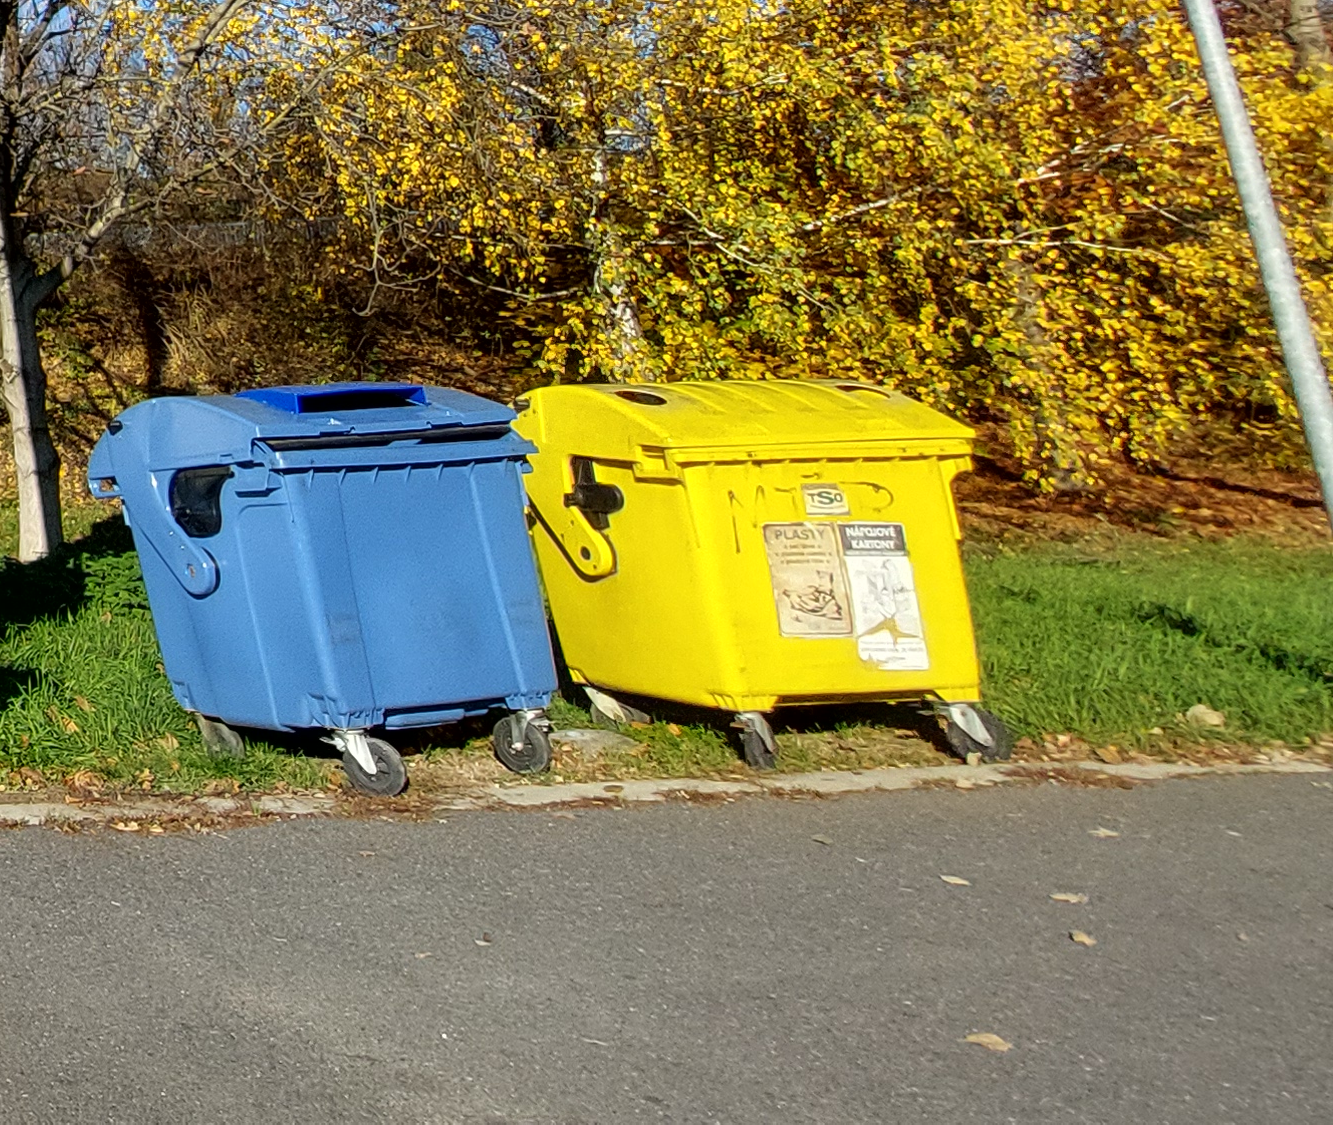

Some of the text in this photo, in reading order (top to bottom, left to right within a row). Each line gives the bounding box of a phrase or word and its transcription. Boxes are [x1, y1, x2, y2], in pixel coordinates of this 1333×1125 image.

[807, 490, 844, 506] TSO
[774, 528, 825, 541] PLASTY
[845, 524, 896, 538] NÁPOJOVÉ
[851, 539, 895, 550] KARTONY
